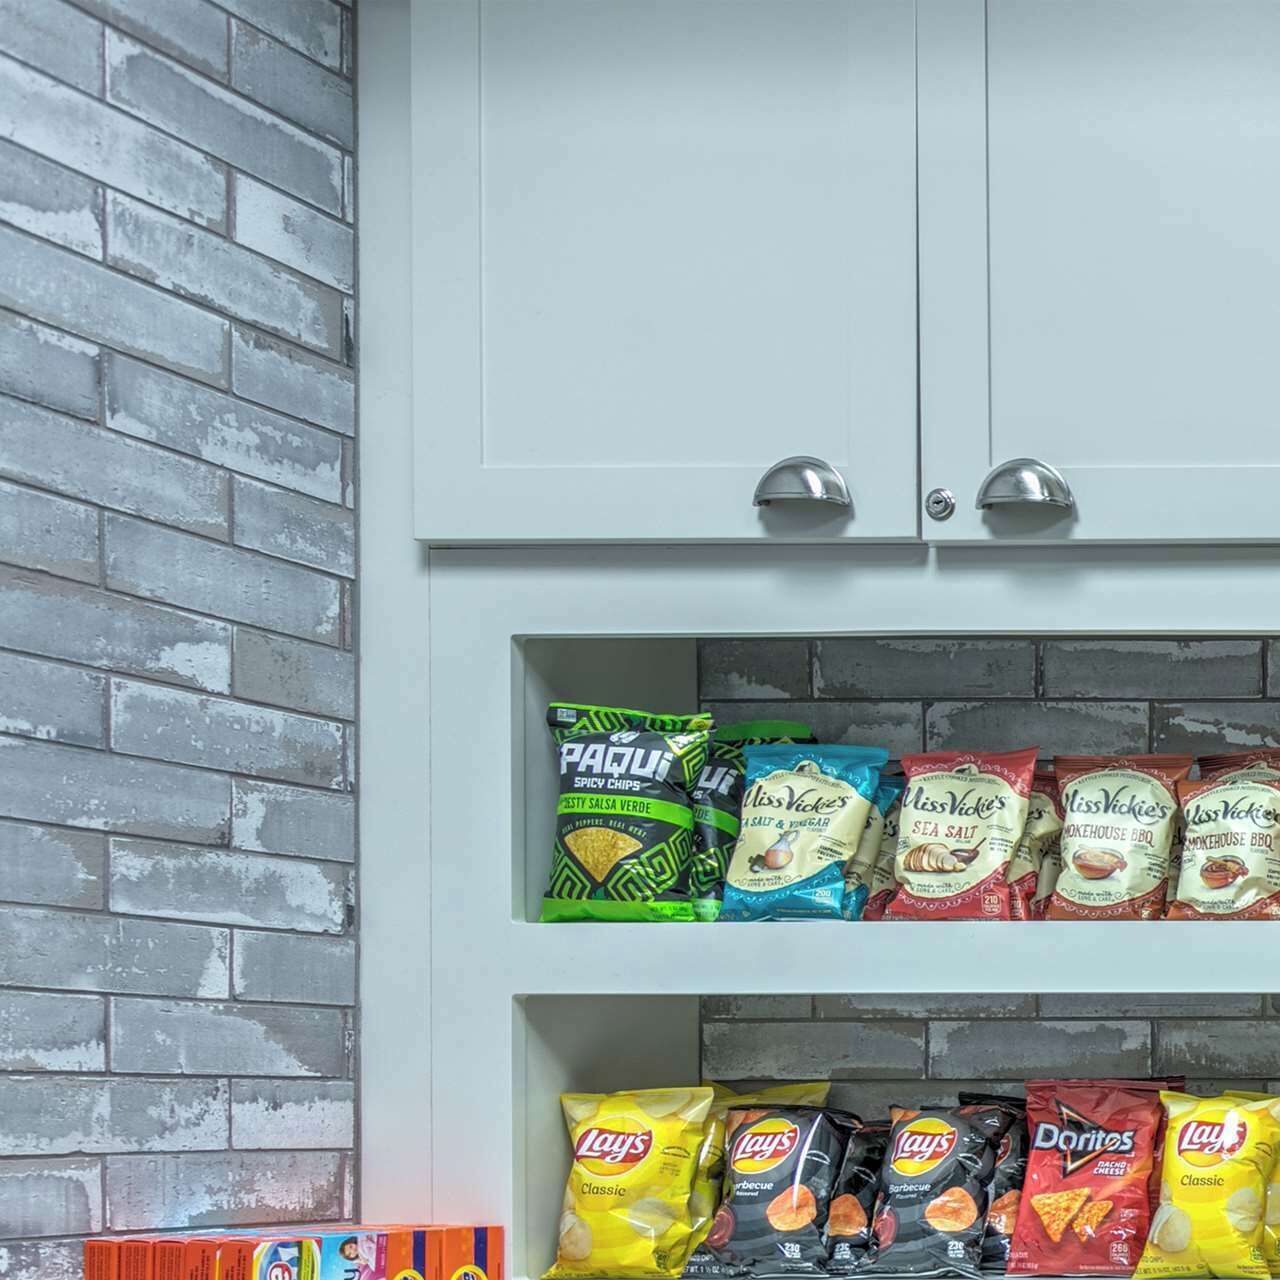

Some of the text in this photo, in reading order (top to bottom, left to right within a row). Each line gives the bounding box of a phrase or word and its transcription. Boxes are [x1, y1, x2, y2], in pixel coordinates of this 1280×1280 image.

[574, 777, 640, 791] SPICY CHIPS
[588, 797, 617, 811] SALSA
[620, 800, 651, 814] VERDE
[945, 788, 1008, 820] Vickie's
[1100, 785, 1170, 825] Vickie's
[751, 817, 776, 828] SALT
[912, 820, 978, 839] SEA SALT
[1064, 824, 1155, 847] MOKEHOUSE BBQ
[1250, 833, 1274, 851] BBQ
[984, 895, 998, 904] 210
[576, 1128, 651, 1163] Lay's
[735, 1130, 795, 1160] Lay's
[1033, 1123, 1135, 1152] Doritos
[897, 1132, 955, 1161] Lay's
[1093, 1166, 1126, 1176] CHEESE
[1097, 1160, 1127, 1168] NACHO
[889, 1184, 931, 1193] Barbecue
[1180, 1174, 1225, 1186] Classic
[581, 1183, 626, 1197] Classic
